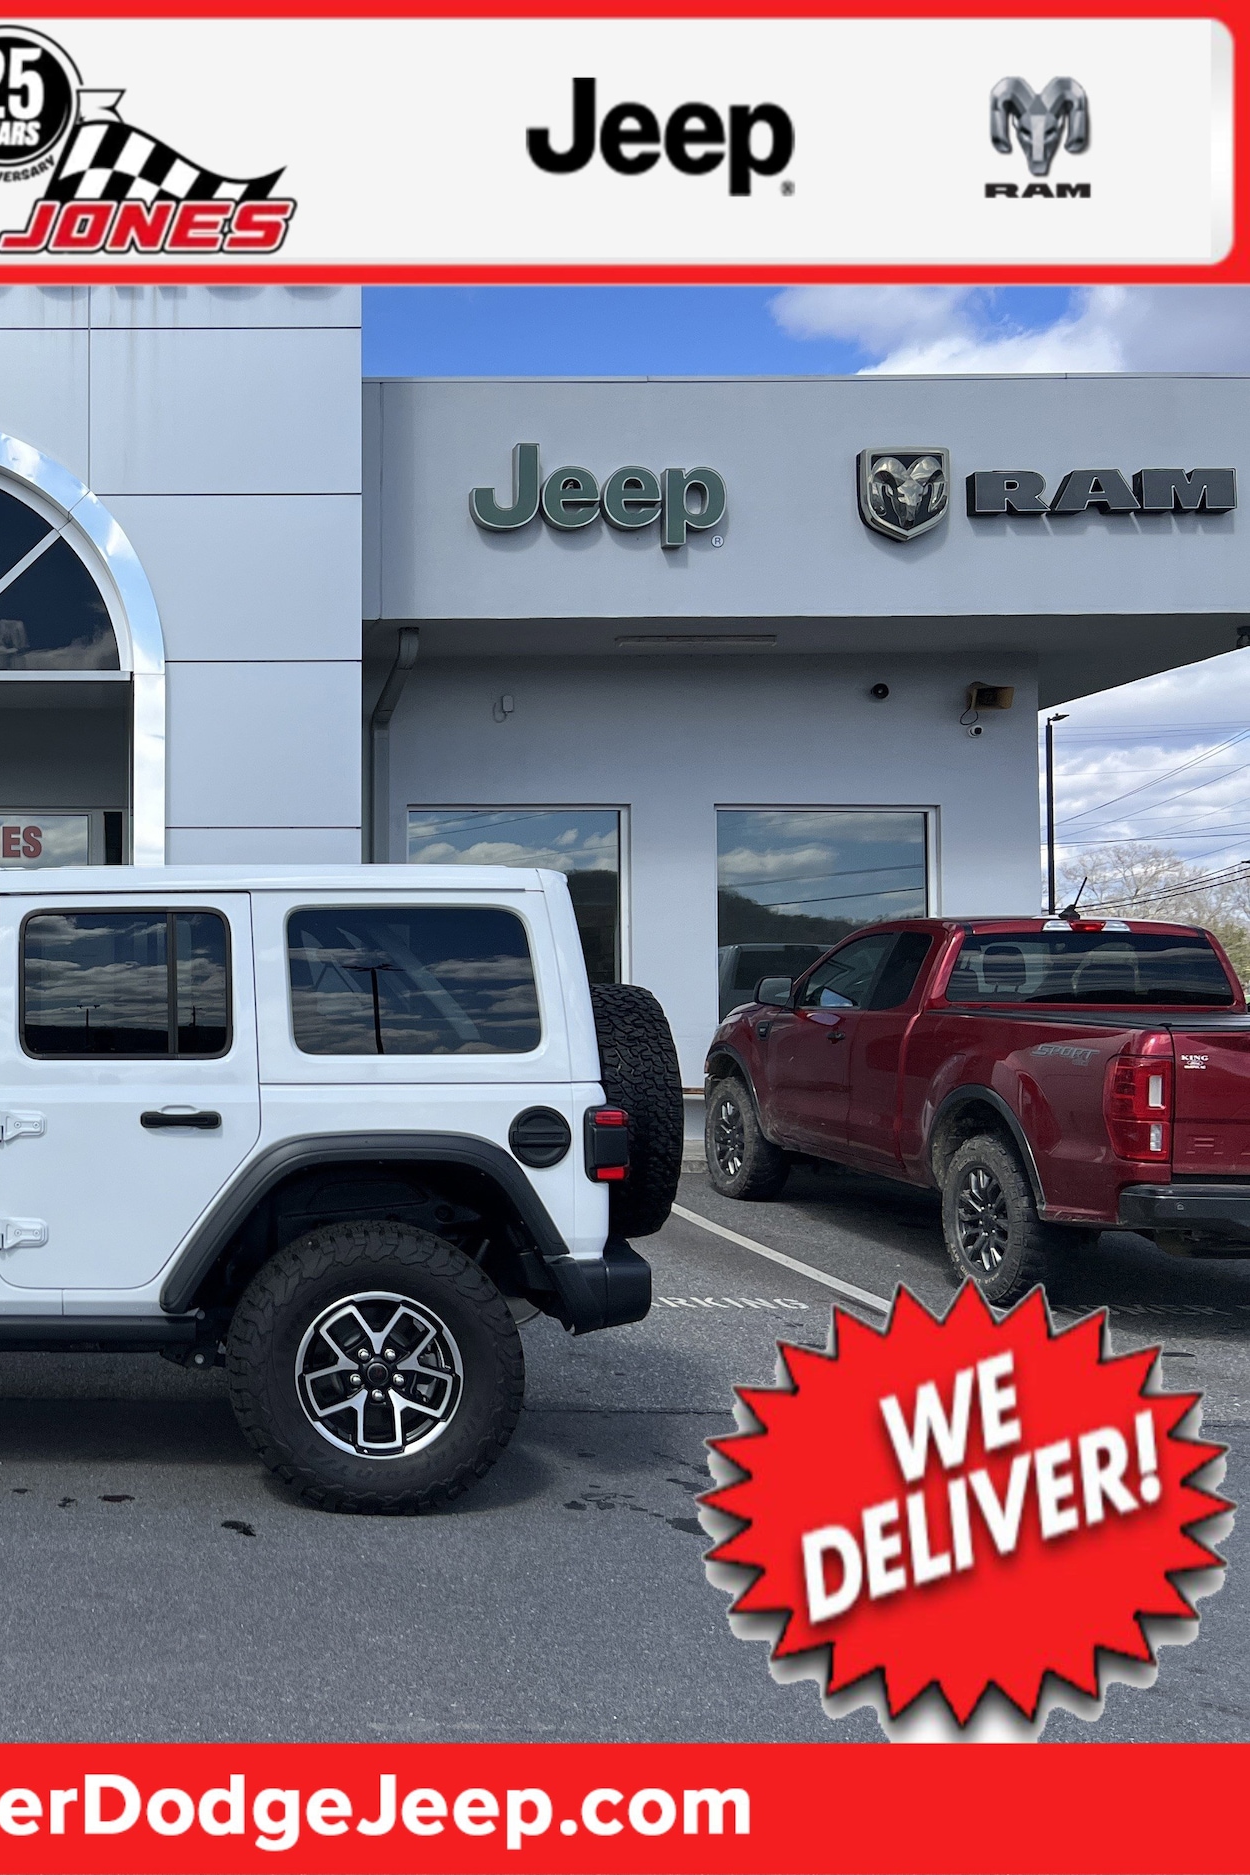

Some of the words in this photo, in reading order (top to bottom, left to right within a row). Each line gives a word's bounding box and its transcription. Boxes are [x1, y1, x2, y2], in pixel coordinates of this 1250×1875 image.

[469, 443, 727, 549] Jeep
[966, 468, 1238, 517] RAM
[1181, 1054, 1209, 1062] KING
[651, 1296, 809, 1309] RKING
